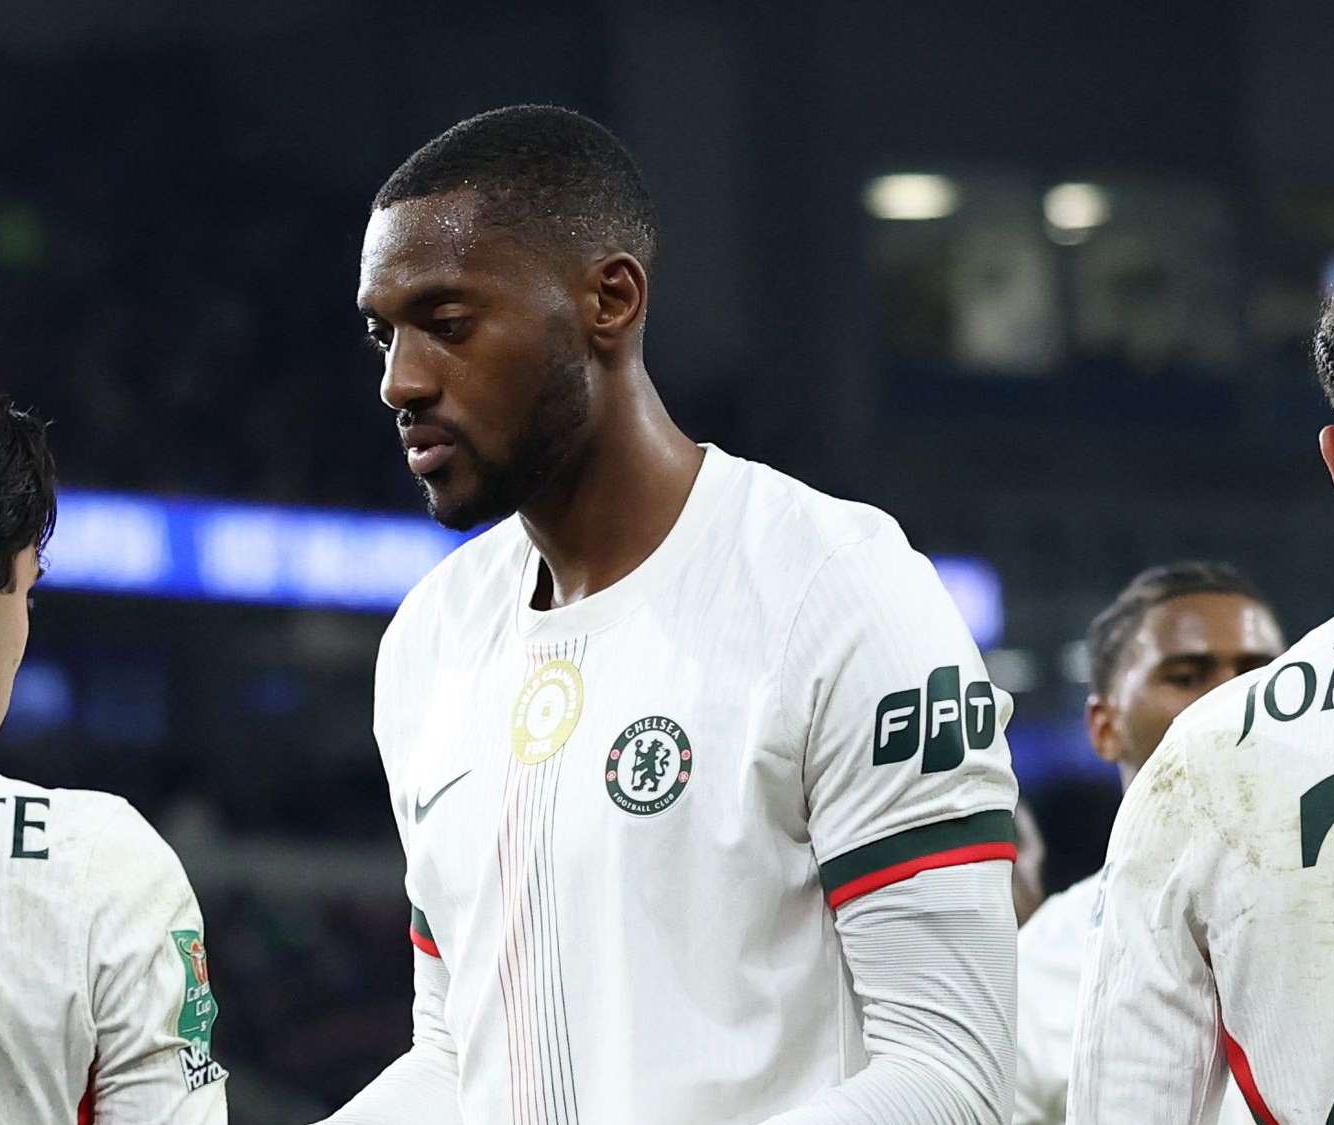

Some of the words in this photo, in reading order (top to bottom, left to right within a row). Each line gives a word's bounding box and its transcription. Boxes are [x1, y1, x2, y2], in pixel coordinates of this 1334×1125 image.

[625, 718, 681, 740] CHELSEA
[613, 792, 651, 813] FOOTBALL
[654, 793, 674, 809] CLUB
